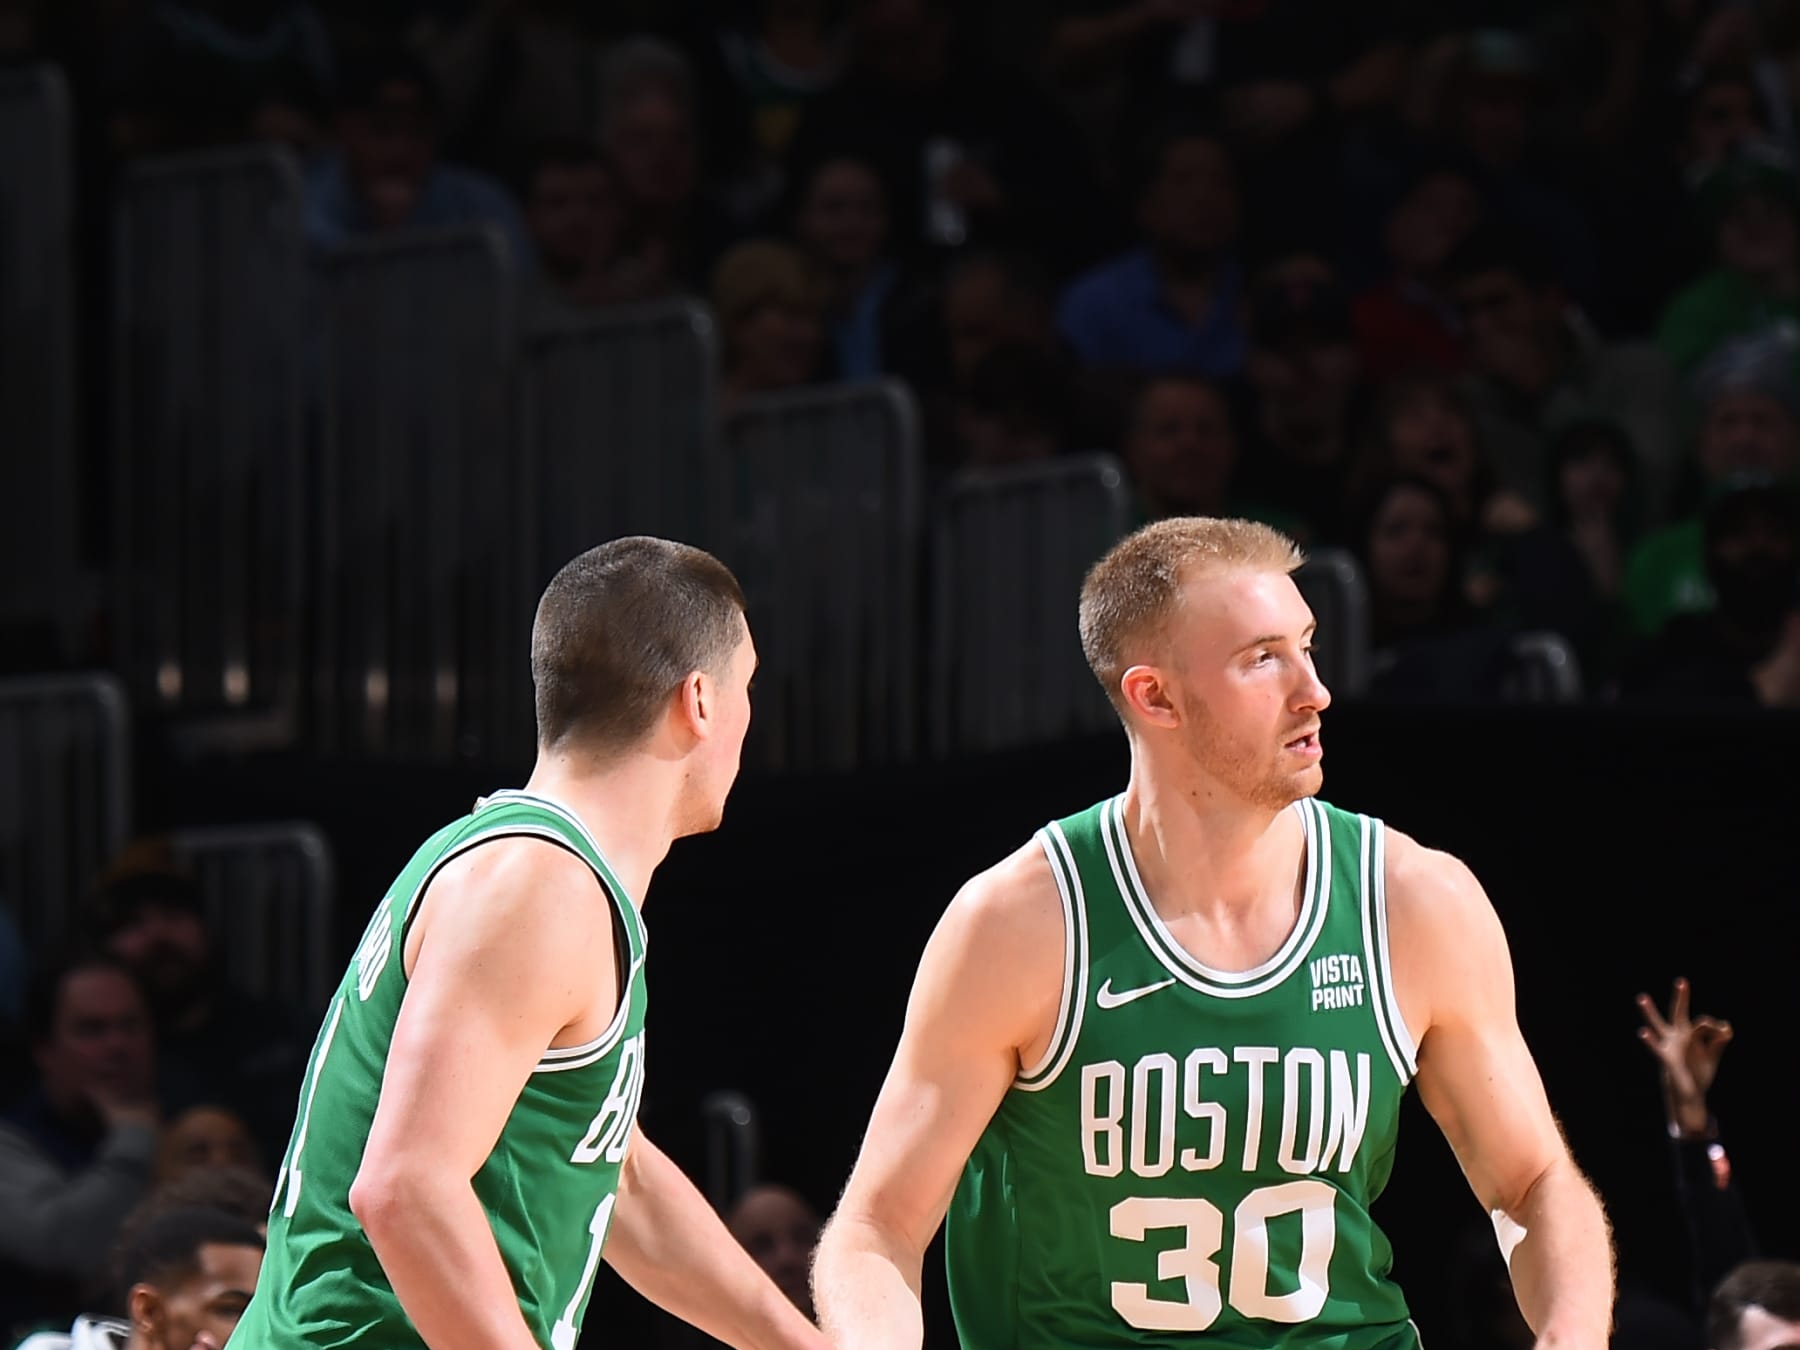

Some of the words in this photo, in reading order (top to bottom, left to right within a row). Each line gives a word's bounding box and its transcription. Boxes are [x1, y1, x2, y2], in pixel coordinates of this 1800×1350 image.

[1310, 954, 1364, 989] VISTA
[1311, 983, 1365, 1012] PRINT
[1080, 1046, 1371, 1178] BOSTON
[1109, 1180, 1338, 1331] 30
